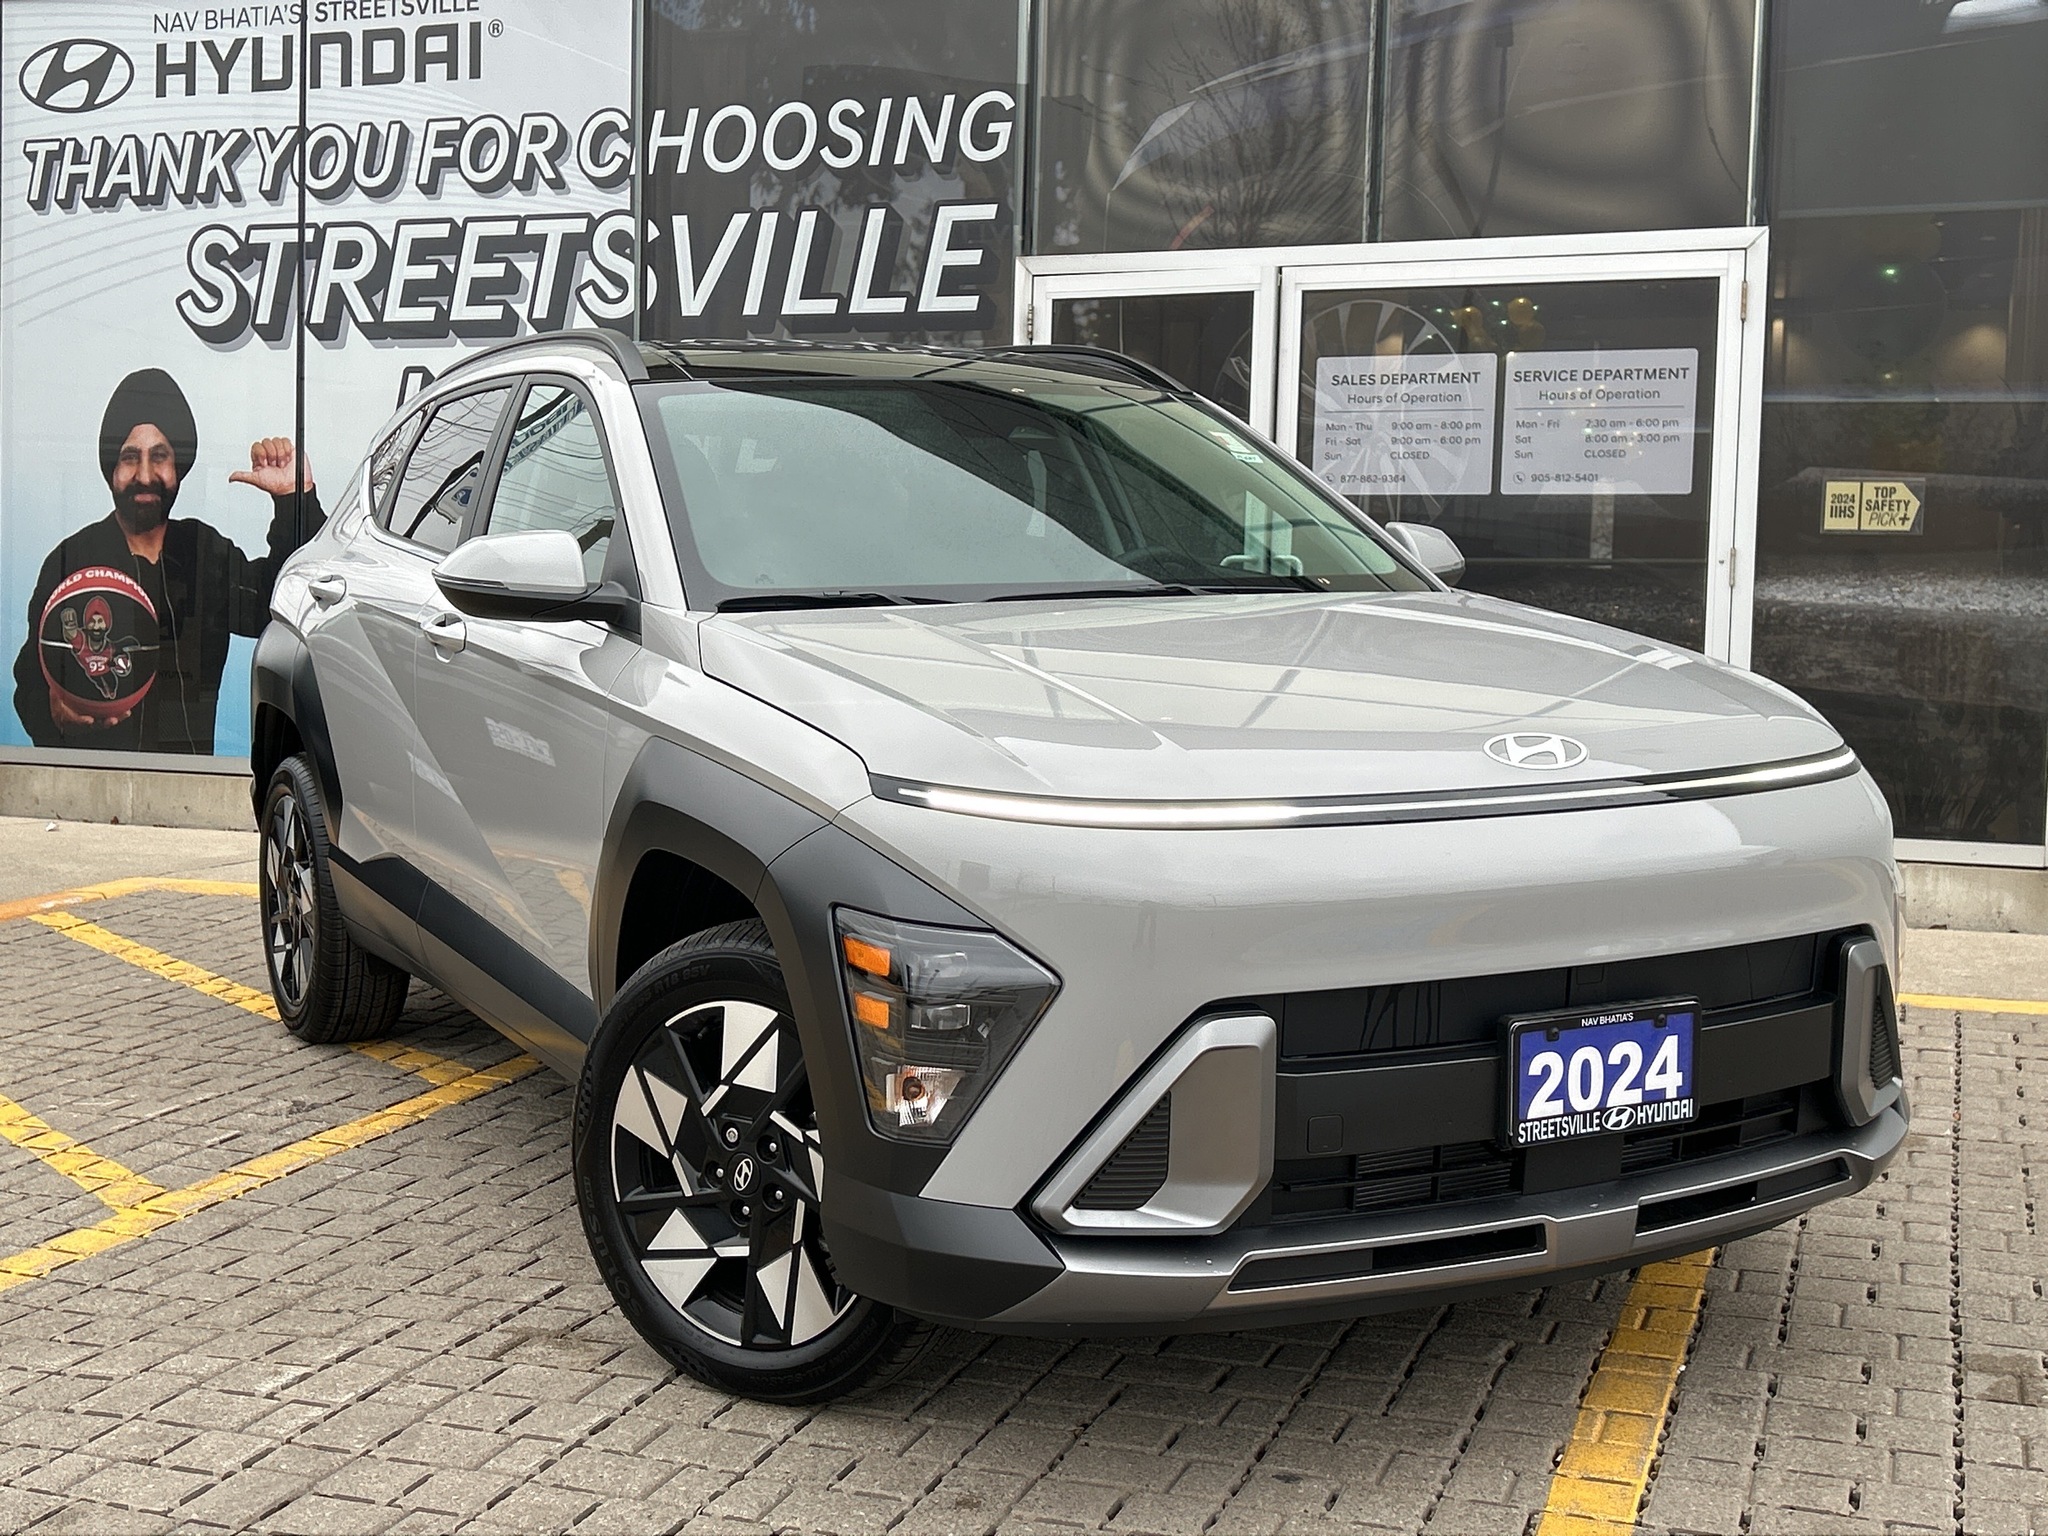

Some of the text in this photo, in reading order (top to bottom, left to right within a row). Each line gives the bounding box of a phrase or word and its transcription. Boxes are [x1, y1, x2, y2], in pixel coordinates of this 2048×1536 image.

[154, 11, 198, 33] NAV
[205, 4, 308, 30] BHATIA'S
[155, 21, 482, 98] HYUNDAI
[23, 90, 1016, 210] THANK YOU FOR CHOOSING
[177, 203, 998, 340] STREETSVILLE
[1331, 372, 1481, 386] SALES DEPARTMENT
[1513, 367, 1690, 382] SERVICE DEPARTMENT
[1347, 393, 1462, 404] Hours of Operation
[1539, 389, 1660, 401] Hours of Operation
[1326, 423, 1347, 431] Mon
[1355, 422, 1373, 431] Thu
[1391, 422, 1413, 431] 9:00
[1441, 421, 1463, 430] 8:00
[1465, 422, 1482, 431] pm
[1516, 420, 1538, 428] Mon
[1547, 419, 1560, 428] Fri
[1635, 418, 1659, 427] 6:00
[1662, 420, 1679, 428] pm
[1325, 437, 1337, 446] Fri
[1345, 437, 1361, 446] Sat
[1391, 437, 1413, 445] 9:00
[1440, 436, 1462, 445] 6:00
[1465, 437, 1481, 446] pm
[1515, 435, 1531, 444] Sat
[1585, 434, 1608, 443] 8:00
[1637, 434, 1660, 443] 3:00
[1663, 435, 1680, 444] pm
[1324, 451, 1430, 461] Sun CLOSED
[1514, 449, 1626, 459] Sun CLOSED
[1531, 473, 1598, 482] 905-812-5401
[1831, 493, 1855, 504] 2024
[1874, 486, 1897, 499] TOP
[1865, 499, 1911, 512] SAFETY
[1830, 505, 1855, 519] IIHS
[1868, 512, 1910, 526] PICK+
[89, 661, 105, 673] 95
[1581, 1012, 1634, 1027] NAV BHATIA'S
[1527, 1034, 1683, 1120] 2024
[1517, 1098, 1693, 1144] STREETSVILLE HYUNDAI
[588, 1213, 643, 1318] SOLUS
